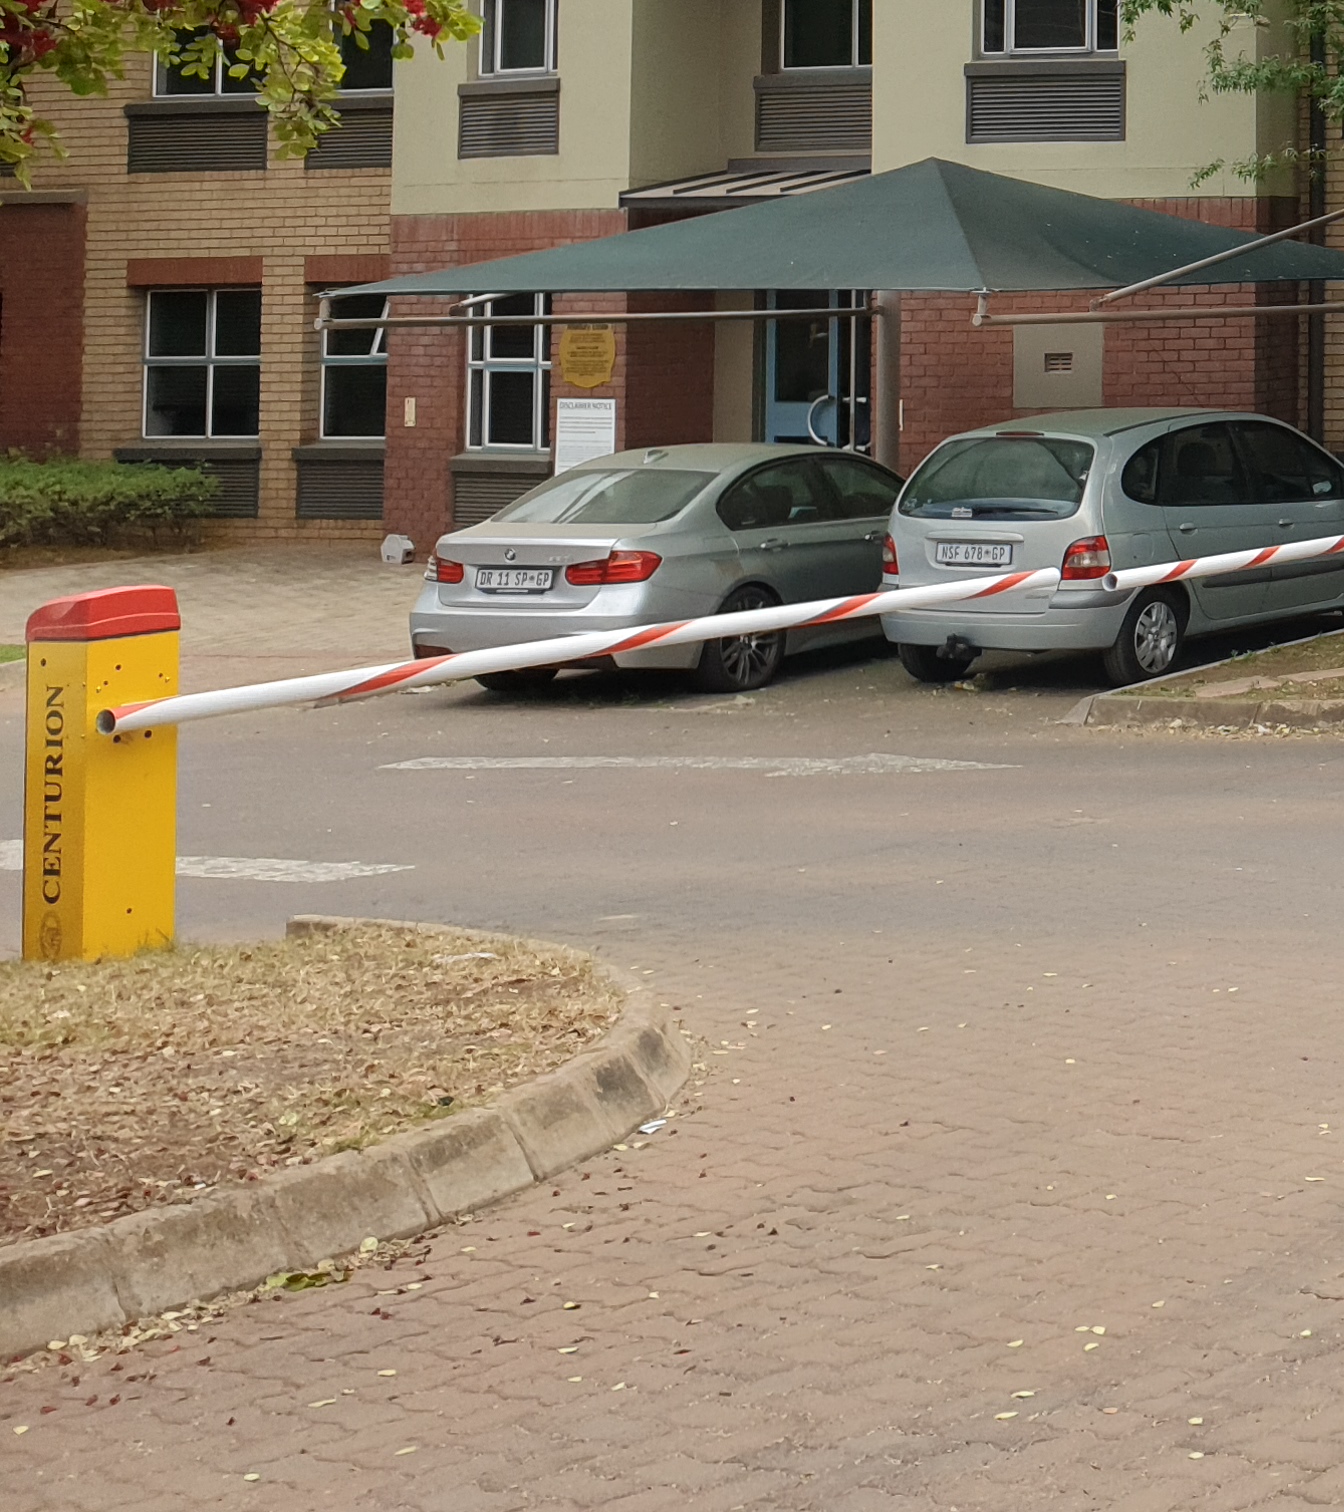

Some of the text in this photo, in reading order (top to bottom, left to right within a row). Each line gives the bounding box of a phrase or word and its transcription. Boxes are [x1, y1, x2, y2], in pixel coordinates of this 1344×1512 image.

[942, 546, 1006, 561] NSF 678 GP
[479, 571, 493, 586] DR
[497, 571, 510, 586] 11
[42, 684, 65, 905] CENTURION
